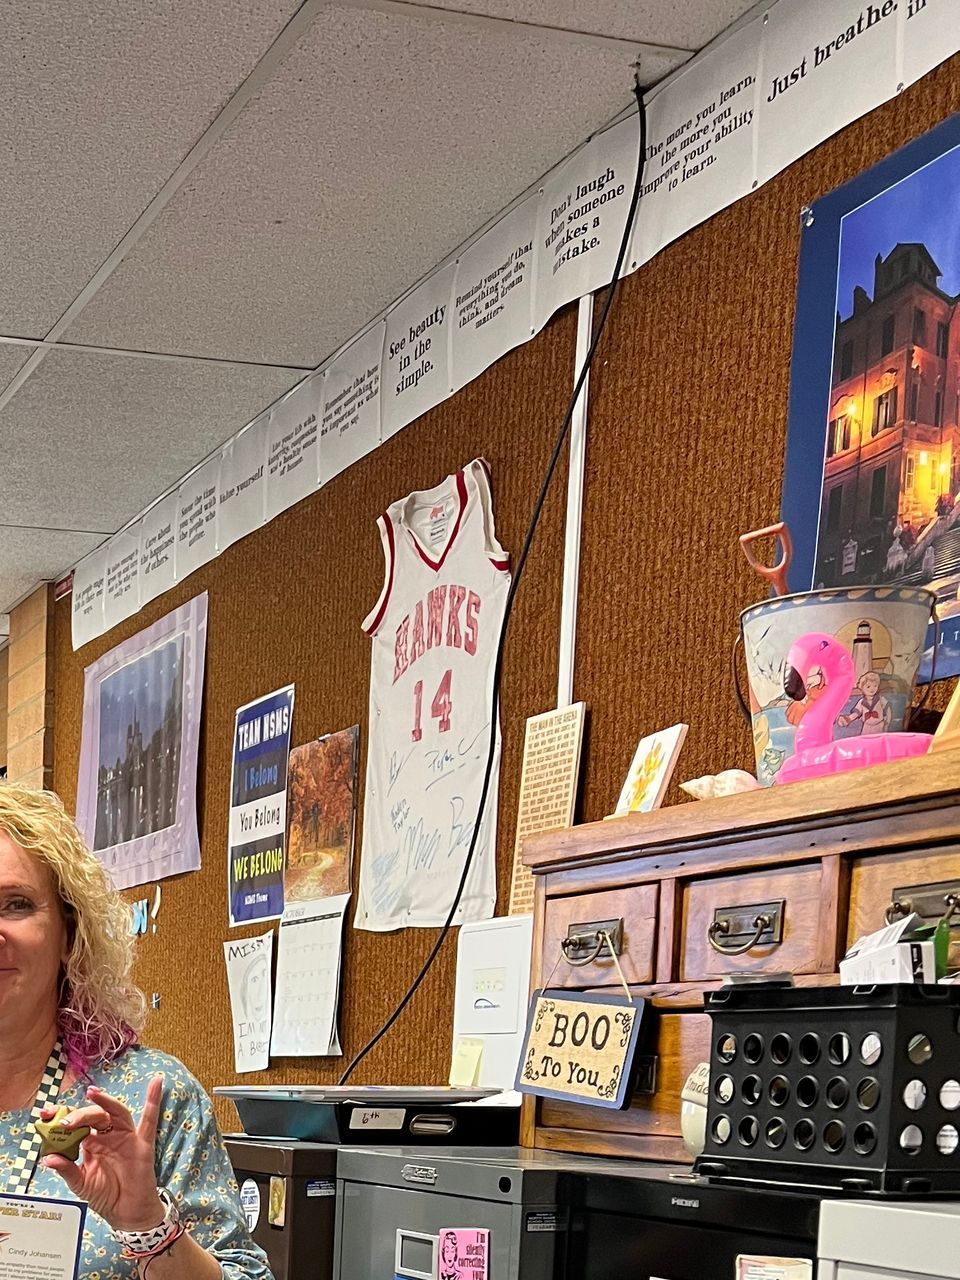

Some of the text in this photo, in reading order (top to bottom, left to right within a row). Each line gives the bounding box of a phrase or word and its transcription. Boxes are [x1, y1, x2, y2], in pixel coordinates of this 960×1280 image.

[767, 0, 898, 102] Just breathe.
[660, 107, 732, 167] the more you
[666, 118, 692, 146] more
[694, 102, 716, 128] you
[639, 109, 754, 198] improve your ability
[575, 167, 616, 200] laugh
[668, 155, 718, 192] to learn.
[545, 183, 625, 249] when someone
[592, 216, 601, 229] a
[455, 240, 533, 308] Remind yourself that
[458, 280, 499, 317] everything
[501, 270, 513, 289] you
[484, 292, 499, 310] and
[500, 274, 523, 299] dream
[389, 304, 447, 360] See beauty
[398, 337, 431, 373] in the
[395, 358, 434, 396] simple.
[392, 584, 481, 686] HAWKS
[411, 669, 453, 743] 14
[238, 705, 290, 752] TEAM NSMS
[249, 764, 278, 790] Belong
[240, 805, 280, 833] You Belong
[233, 847, 283, 883] WE BELONG
[548, 1010, 611, 1051] BOO
[541, 1055, 600, 1087] To You
[21, 1208, 63, 1221] STAR!
[8, 1247, 62, 1259] Cindy Johansen
